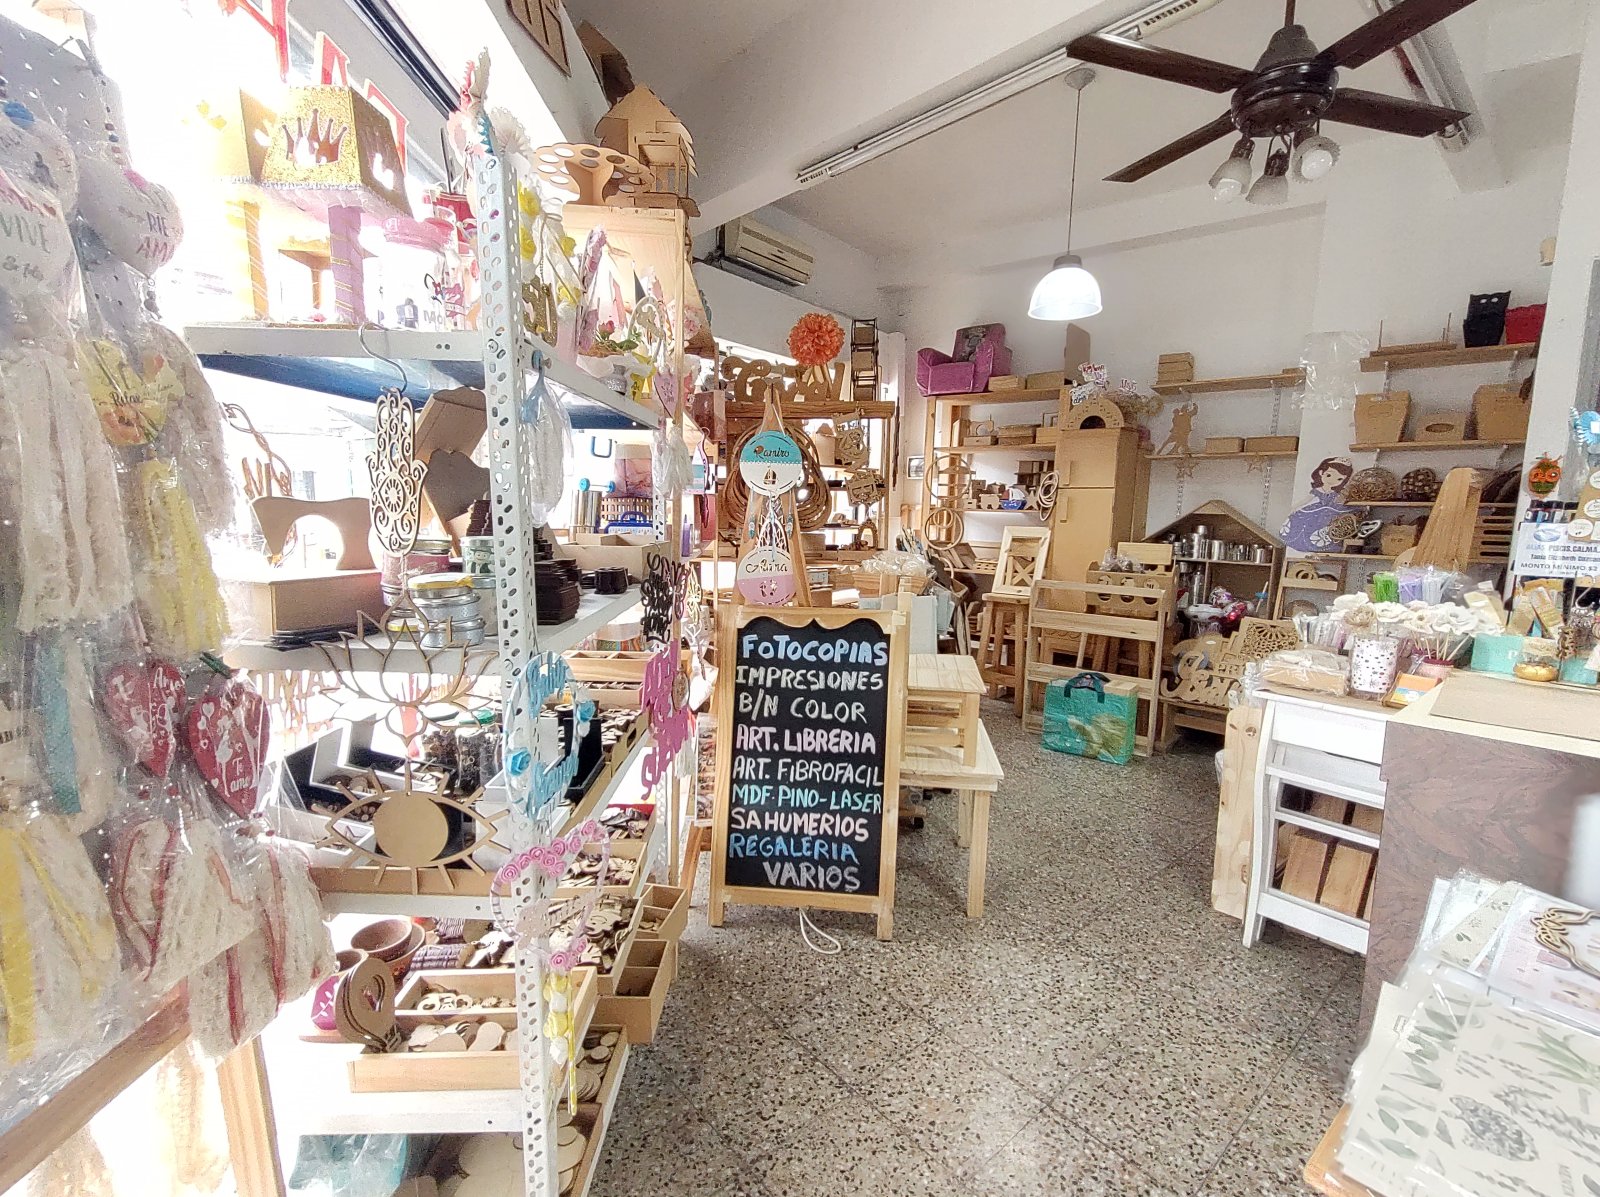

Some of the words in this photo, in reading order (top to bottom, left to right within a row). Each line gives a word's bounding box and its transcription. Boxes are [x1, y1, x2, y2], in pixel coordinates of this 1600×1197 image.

[753, 445, 791, 460] Ramiro
[735, 665, 885, 692] IMPRESIONES
[738, 688, 779, 721] B/N
[789, 697, 868, 724] COLOR
[735, 723, 780, 753] ART.
[783, 728, 876, 754] LIBRERIA
[732, 755, 770, 781] ART.
[776, 758, 885, 788] FIBROFACIL
[730, 806, 870, 842] SAHUMERIOS
[728, 832, 861, 865] REGALERIA
[762, 861, 862, 893] VARIOS
